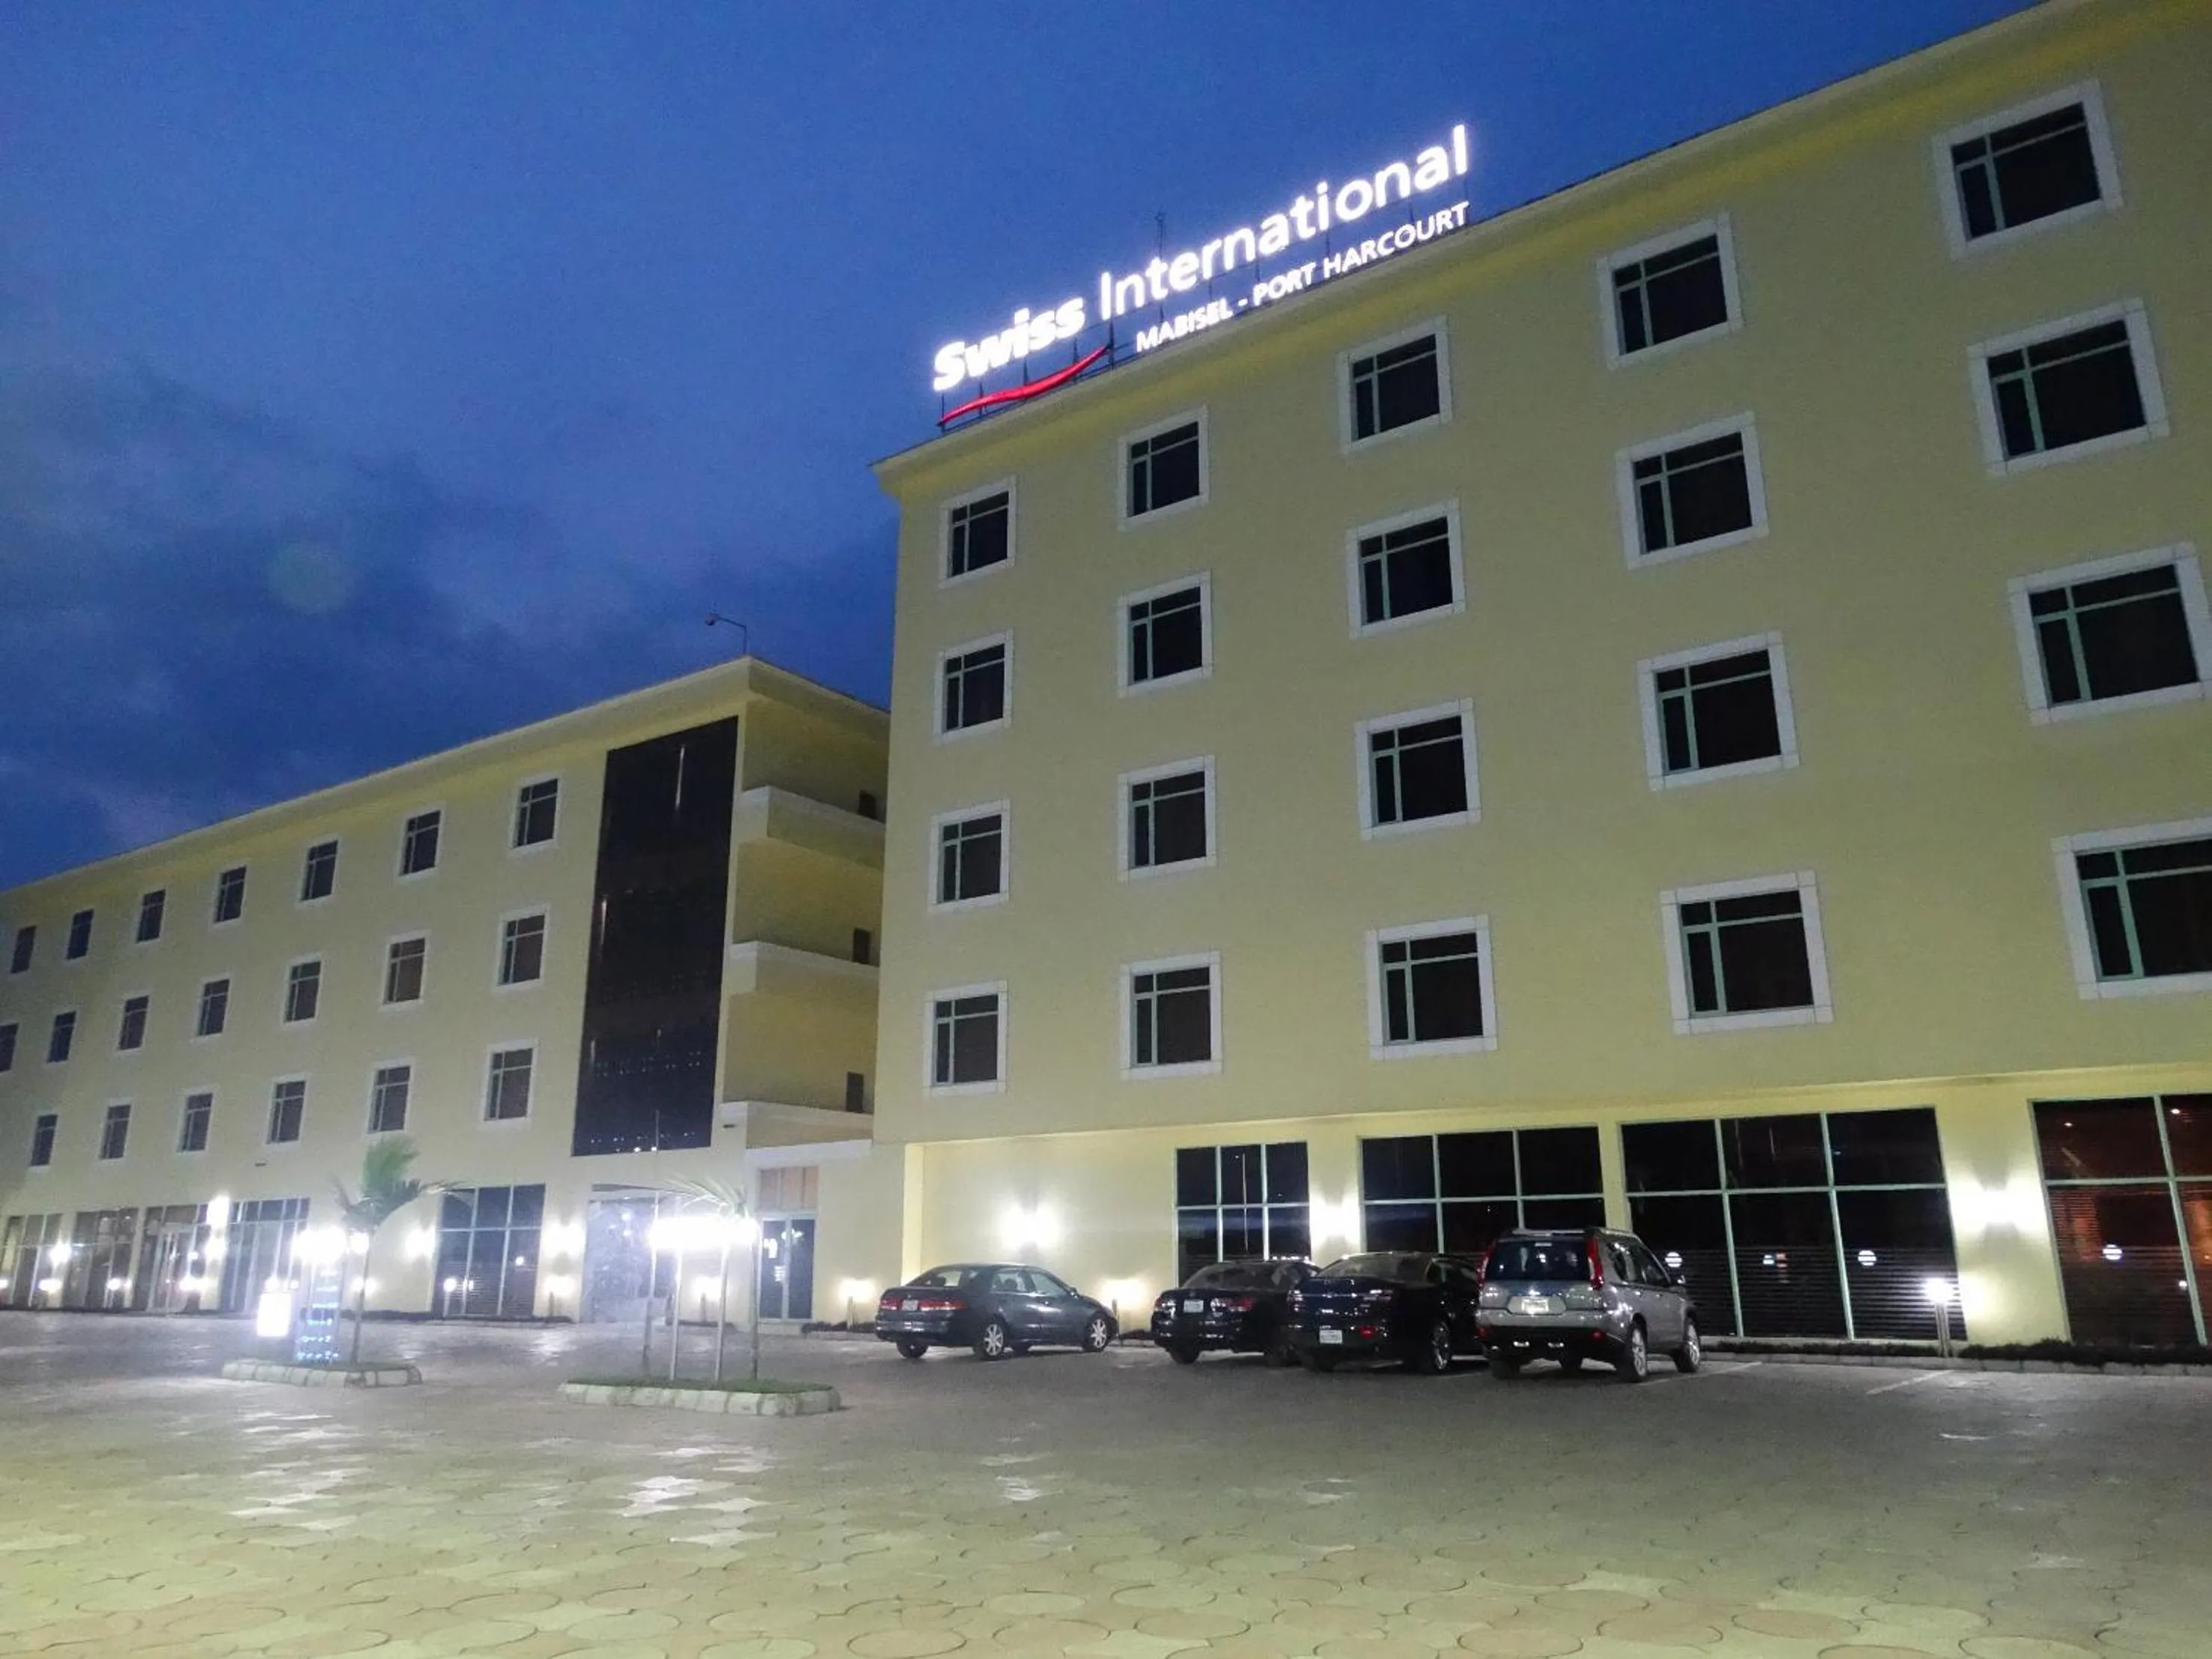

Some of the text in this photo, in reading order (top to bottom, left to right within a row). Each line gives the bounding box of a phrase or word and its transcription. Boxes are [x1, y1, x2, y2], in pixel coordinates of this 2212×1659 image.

[933, 124, 1468, 392] Swiss International
[1136, 297, 1234, 353] MABISEL
[1253, 261, 1317, 306] PORT
[1323, 201, 1469, 279] HARCOURT
